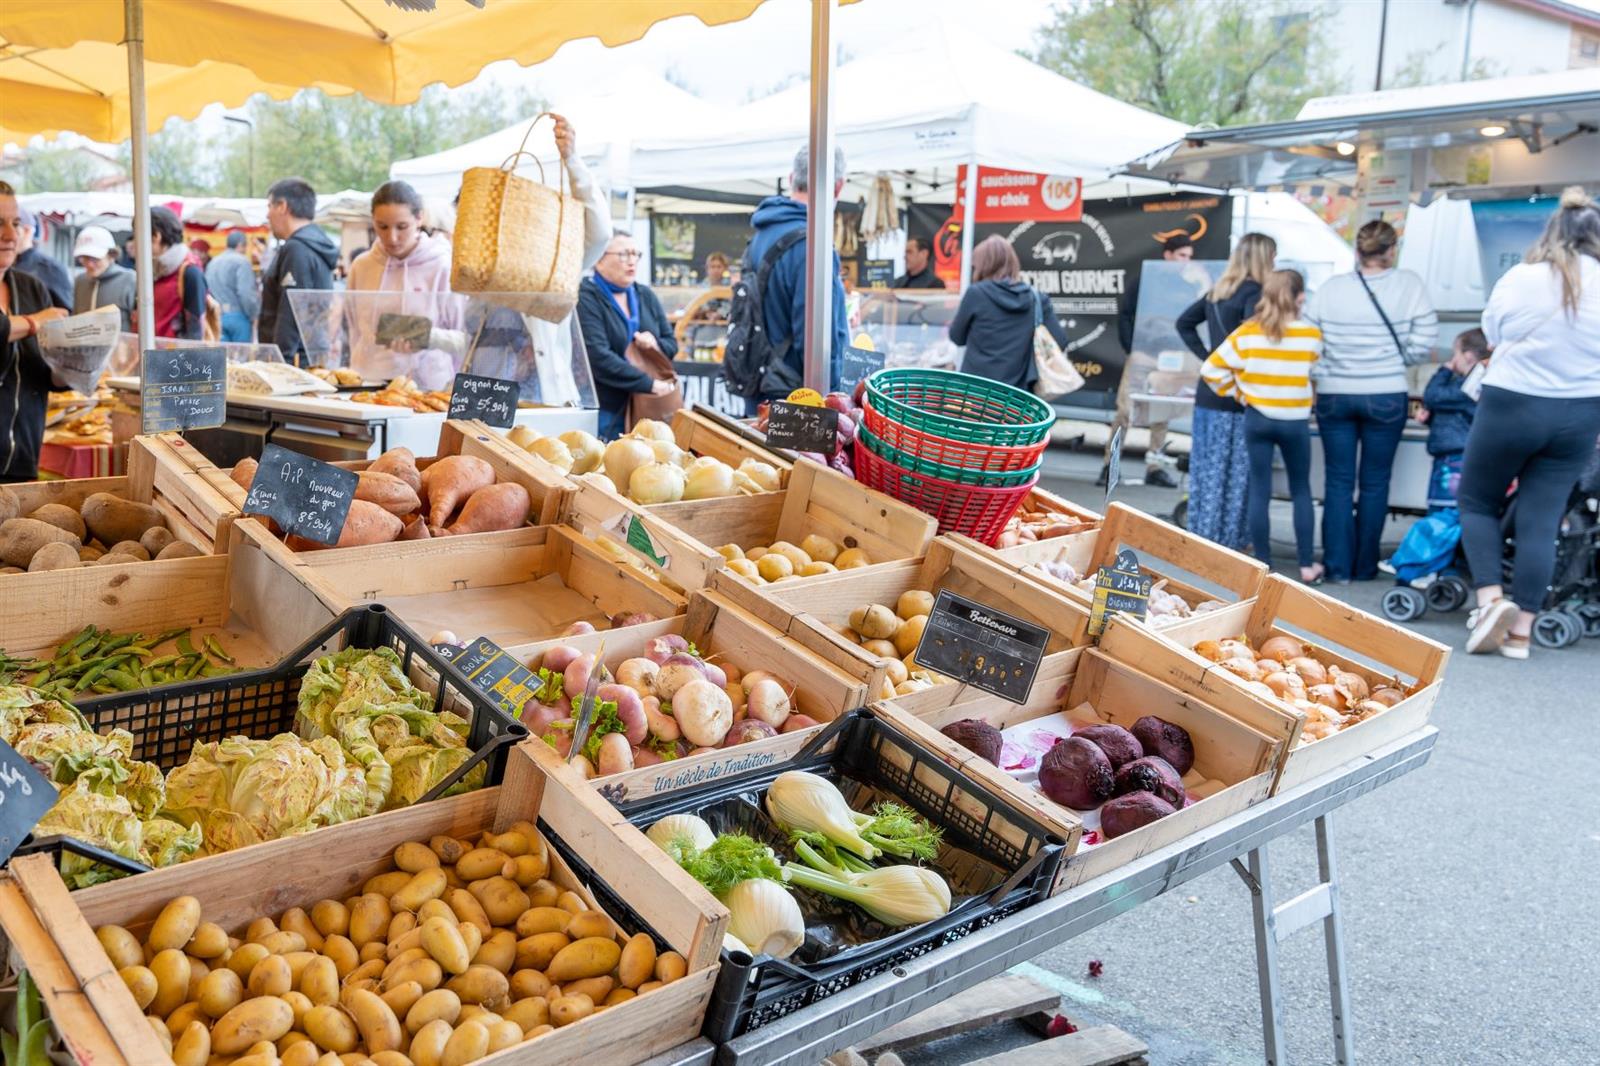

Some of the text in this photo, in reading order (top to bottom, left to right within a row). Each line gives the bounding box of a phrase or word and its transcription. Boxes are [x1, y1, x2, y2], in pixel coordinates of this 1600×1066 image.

[981, 174, 1038, 188] saucissons
[1047, 181, 1073, 199] 10€
[986, 191, 1030, 207] au choix
[1061, 269, 1126, 294] GOURMET
[190, 406, 215, 415] DOUCE
[1097, 568, 1113, 588] Prix
[969, 609, 1017, 636] Betterave
[654, 752, 776, 792] Un siècle de Tradition
